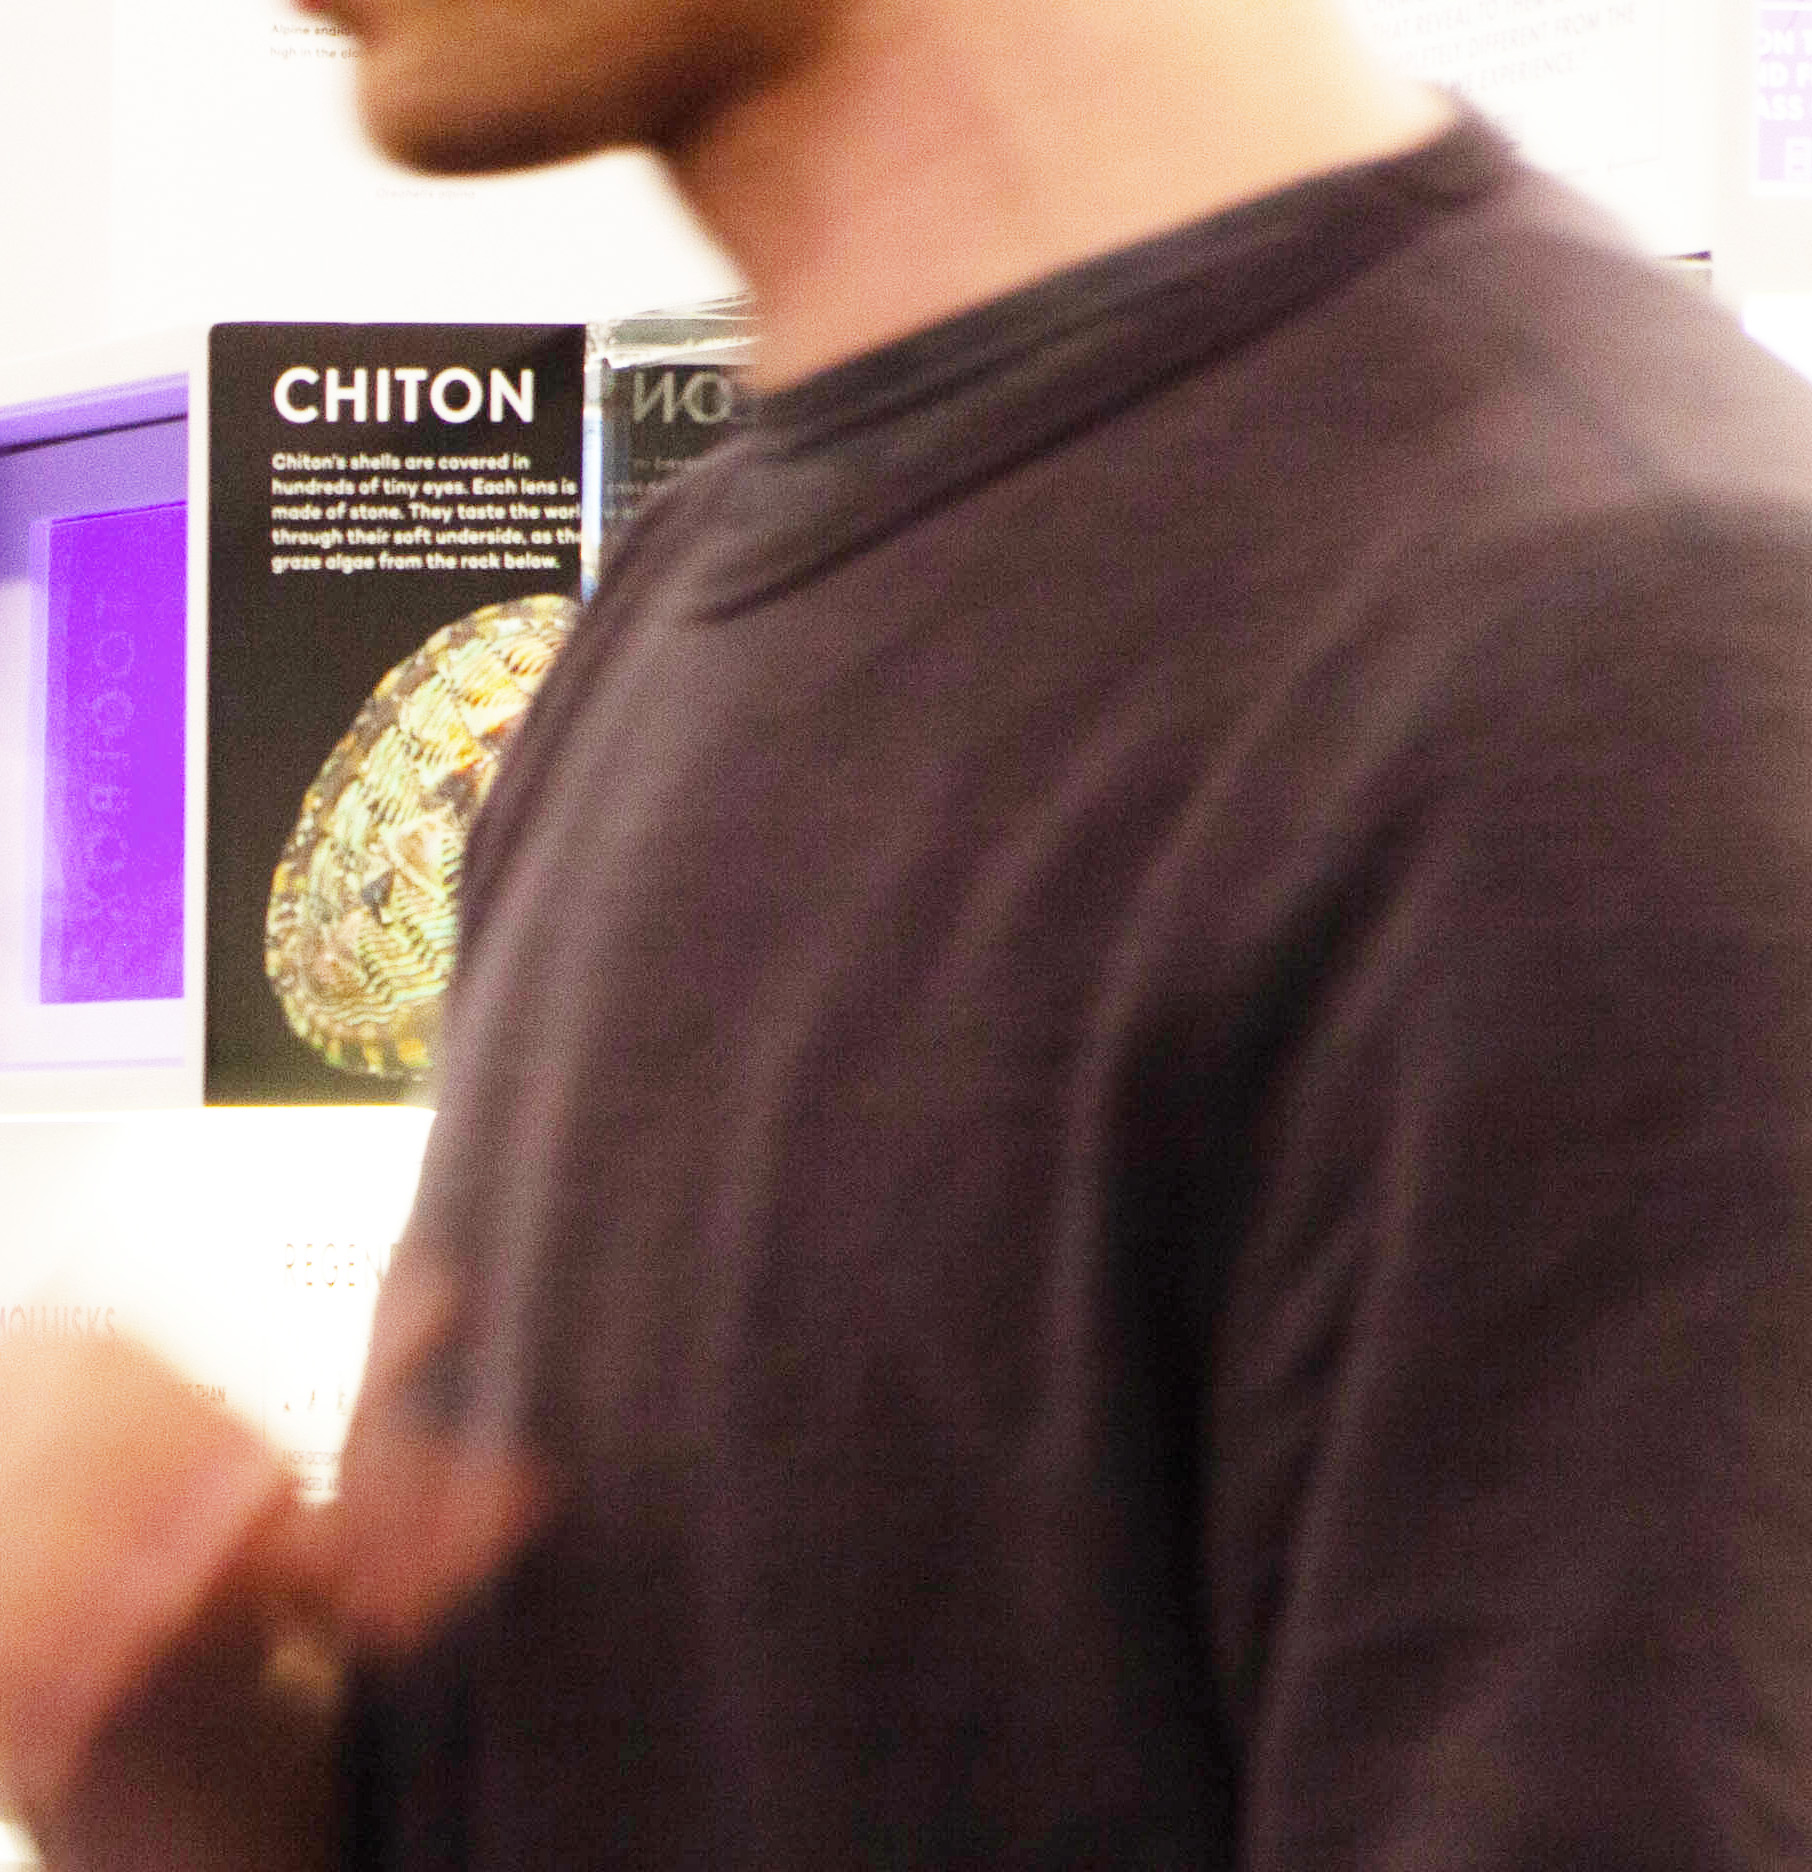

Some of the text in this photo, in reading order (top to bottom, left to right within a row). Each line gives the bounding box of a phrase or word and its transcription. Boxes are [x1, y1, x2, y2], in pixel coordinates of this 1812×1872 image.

[274, 366, 534, 424] CHITON
[350, 452, 402, 471] shells
[404, 456, 436, 471] are
[437, 453, 510, 471] covered
[512, 452, 531, 470] in
[271, 477, 356, 496] hundreds
[358, 476, 380, 496] of
[382, 477, 419, 499] tiny
[471, 477, 518, 496] Each
[520, 477, 558, 496] lens
[560, 478, 578, 496] is
[271, 503, 324, 521] made
[325, 501, 347, 521] of
[407, 501, 455, 524] They
[456, 504, 507, 521] taste
[508, 502, 542, 520] the
[271, 528, 344, 550] through
[346, 527, 391, 546] their
[393, 525, 433, 546] soft
[530, 530, 553, 545] as
[270, 556, 322, 575] graze
[323, 553, 376, 575] algae
[377, 550, 424, 571] from
[425, 552, 458, 570] the
[460, 552, 501, 570] rock
